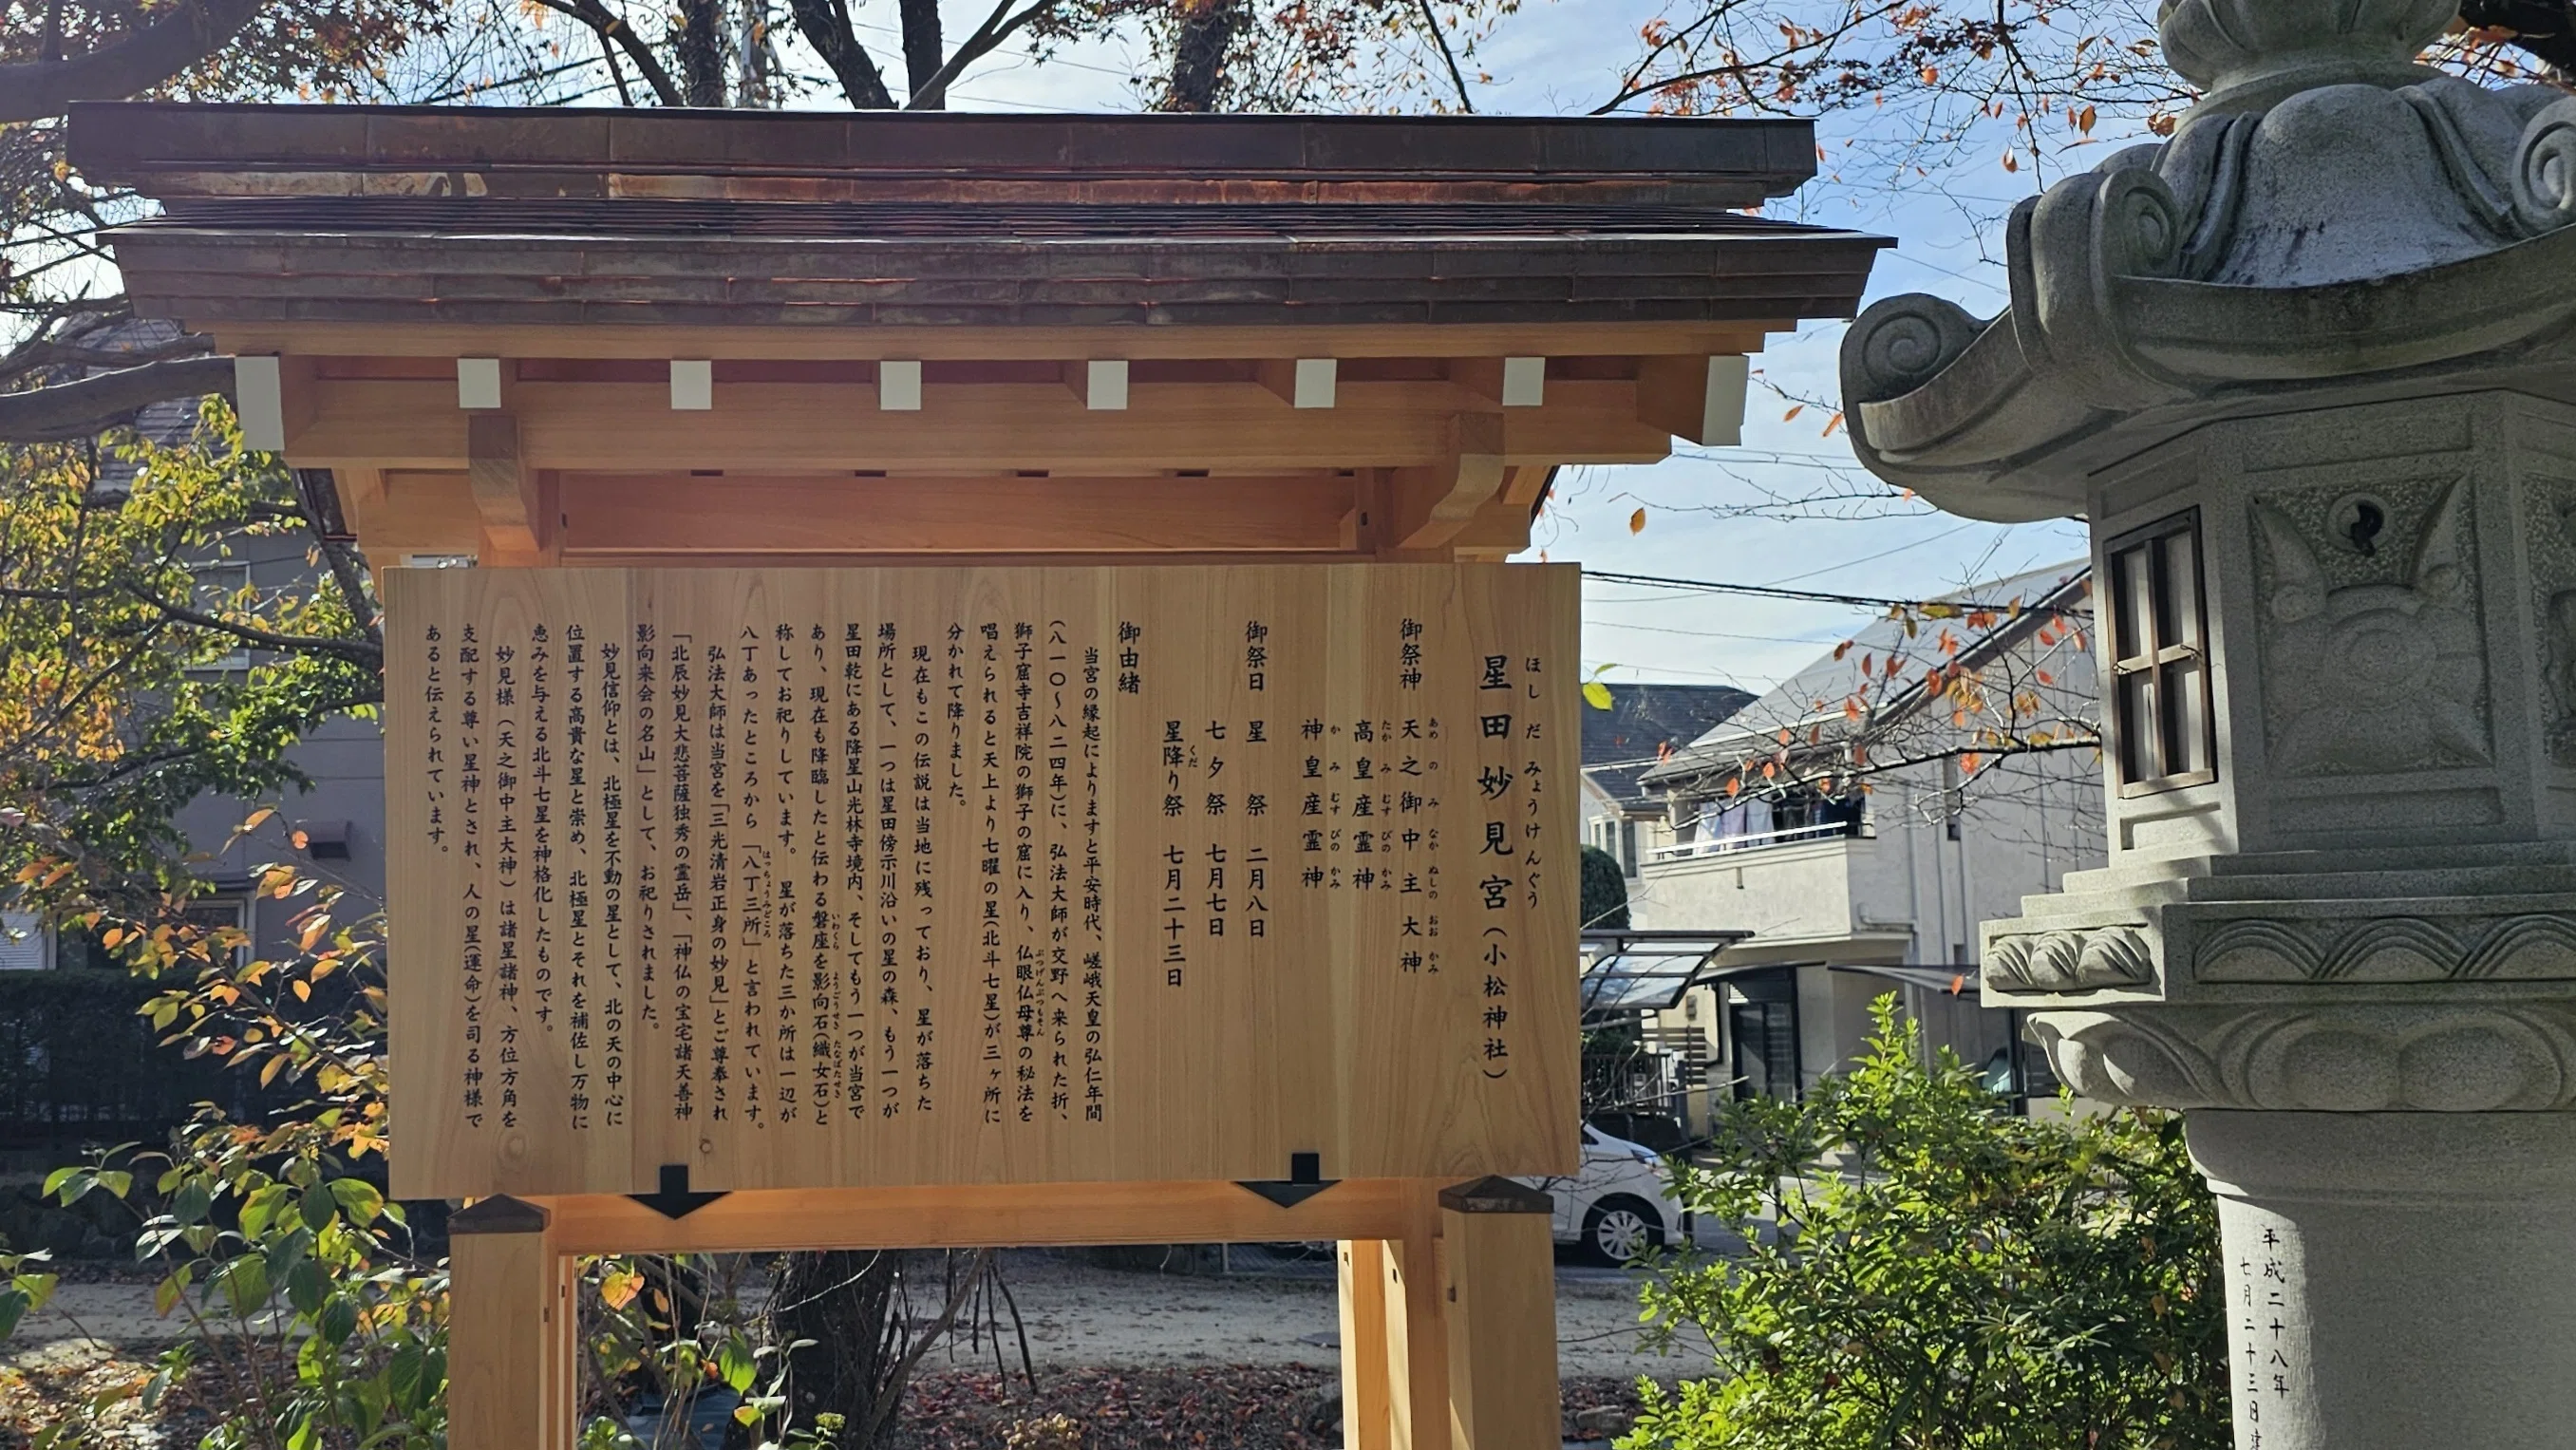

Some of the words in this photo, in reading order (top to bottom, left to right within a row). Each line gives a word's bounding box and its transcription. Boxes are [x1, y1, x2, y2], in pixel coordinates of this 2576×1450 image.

[1118, 621, 1140, 694] 御由緒
[1246, 621, 1268, 691] 御祭日
[1400, 618, 1422, 690] 御祭神
[1162, 721, 1185, 817] 星降り祭
[1205, 721, 1227, 816] 七夕祭
[1301, 719, 1324, 889] 神皇産霊神
[1352, 720, 1375, 891] 高皇産霊神
[1205, 844, 1227, 936] 七月七日
[1246, 848, 1269, 937] 二月八日
[1399, 719, 1422, 973] 天之御中主大神
[1163, 845, 1186, 987] 七月二十三日
[2262, 1229, 2290, 1399] 平成二十八年
